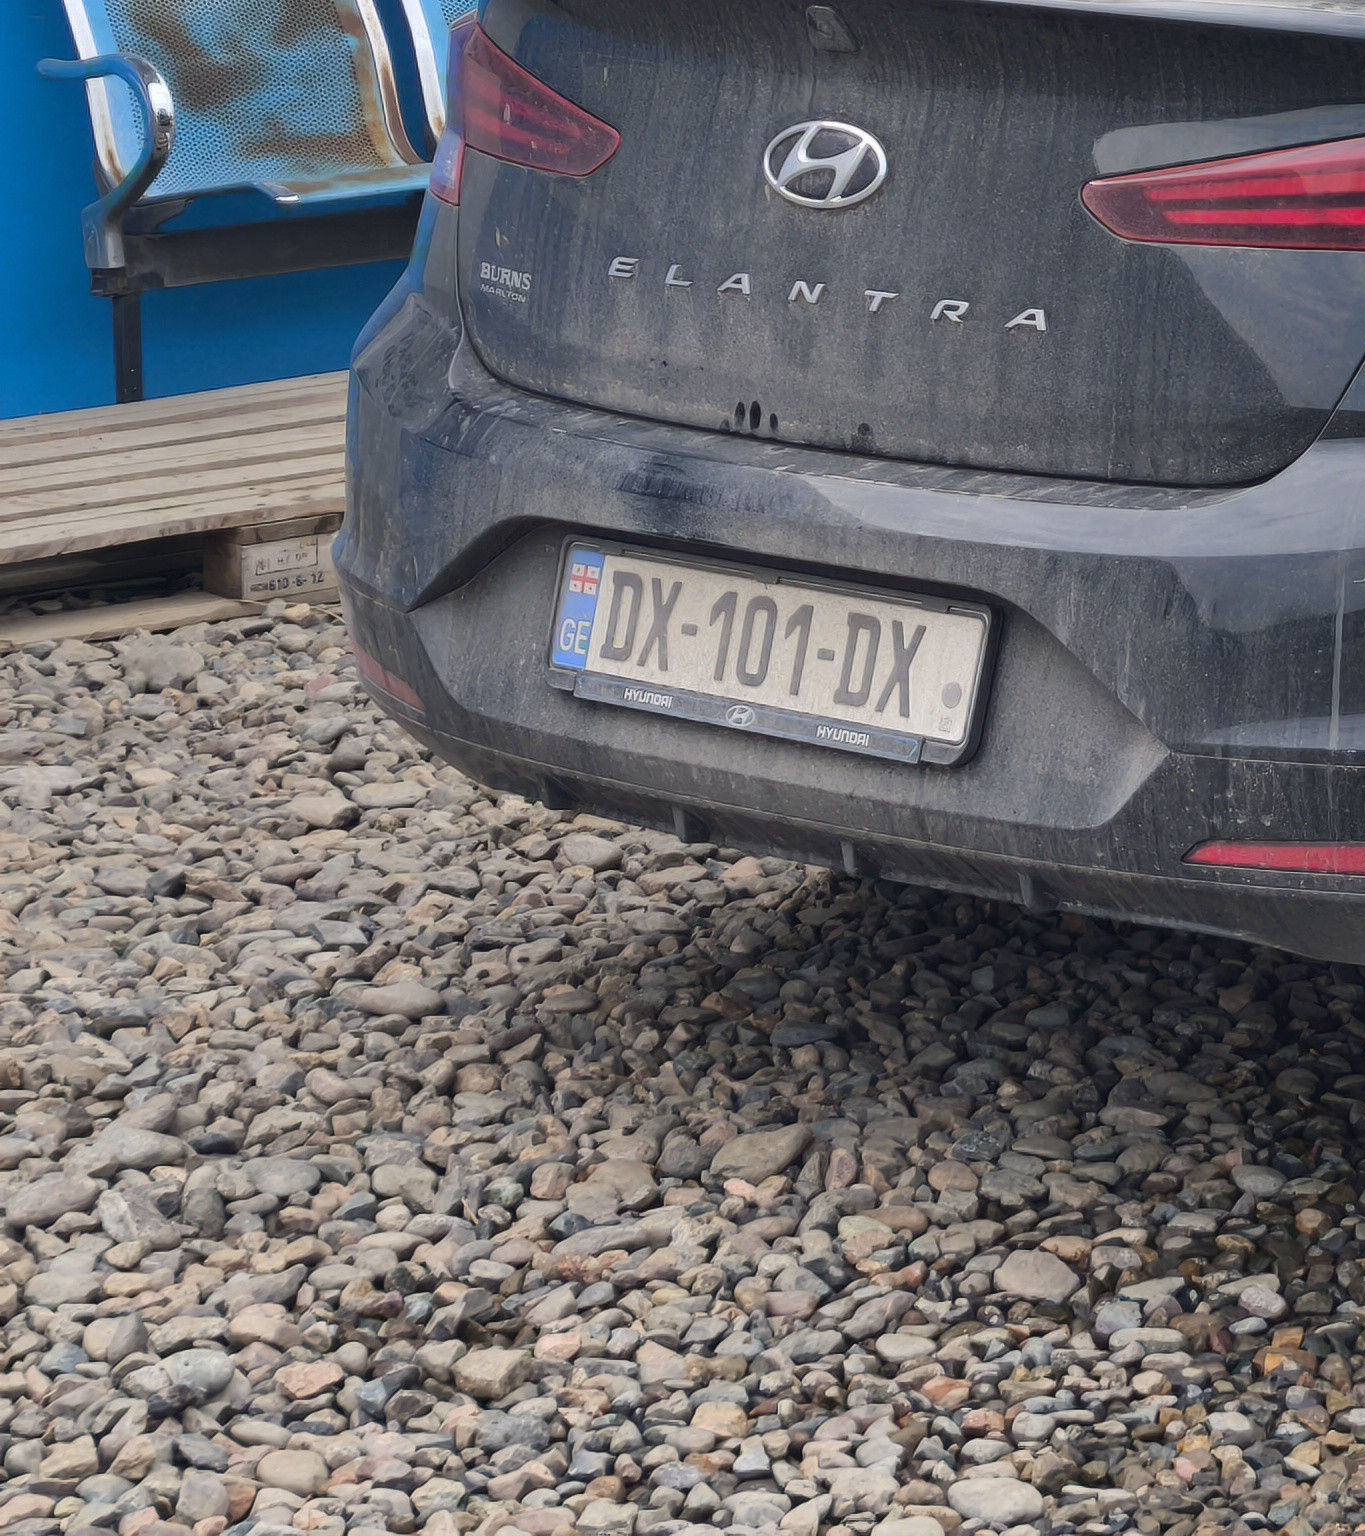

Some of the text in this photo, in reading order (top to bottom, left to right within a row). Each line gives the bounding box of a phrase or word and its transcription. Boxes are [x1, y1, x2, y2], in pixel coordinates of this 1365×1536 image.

[480, 261, 532, 291] BURNS
[480, 283, 526, 303] MARLTON
[608, 256, 1046, 332] ELANTRA
[560, 618, 592, 655] GE
[599, 569, 927, 719] DX-101-DX
[623, 687, 673, 710] HYUNDAI
[815, 724, 871, 748] HYUNDAI
